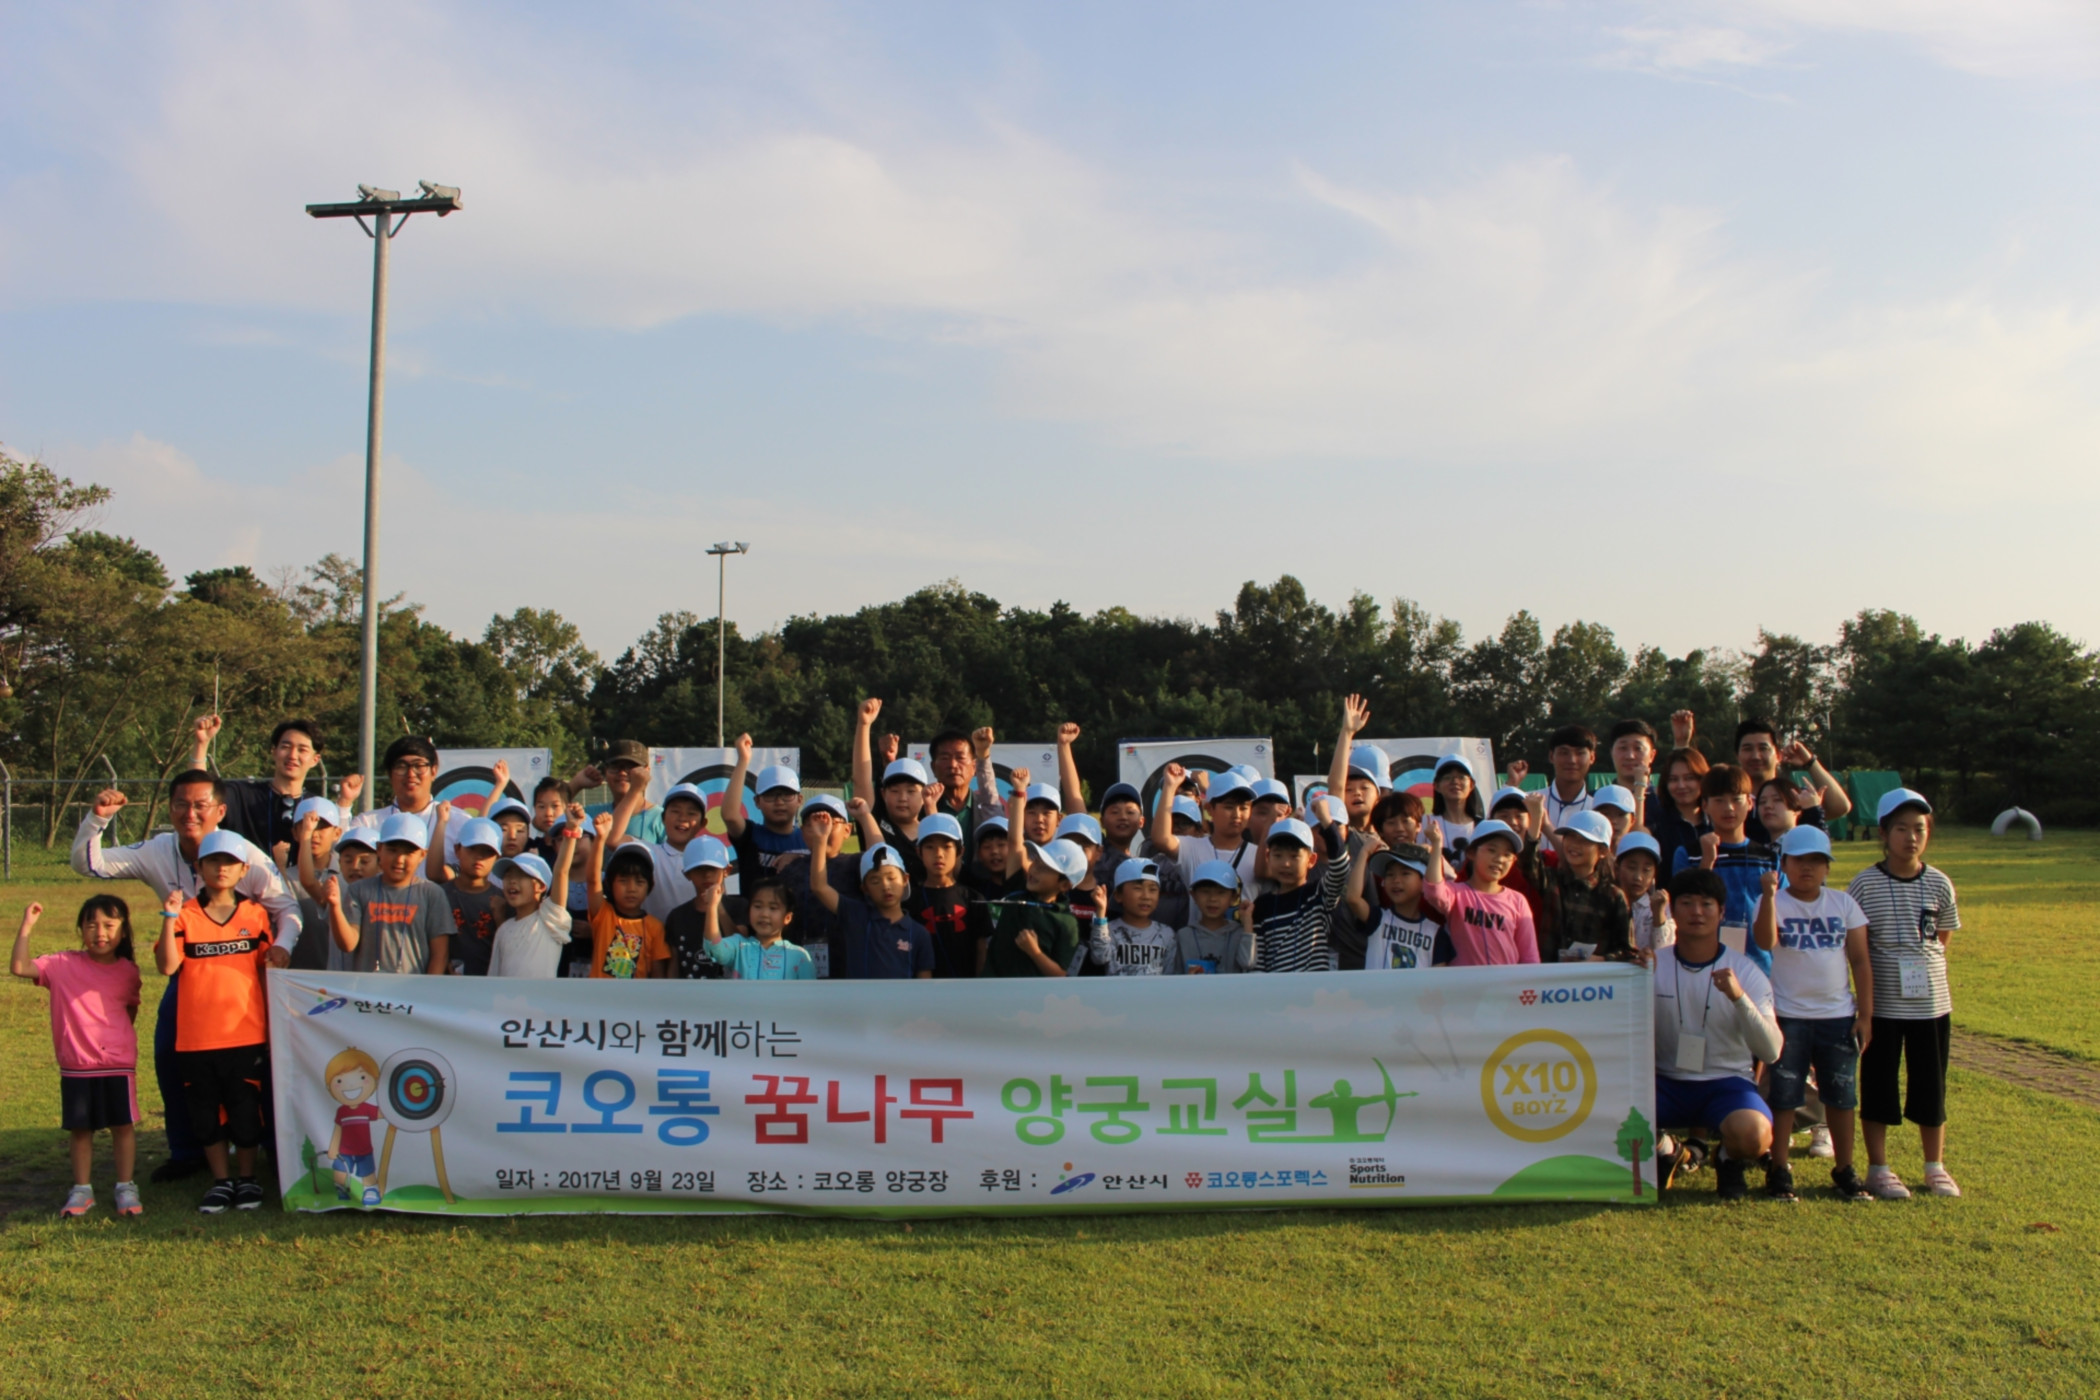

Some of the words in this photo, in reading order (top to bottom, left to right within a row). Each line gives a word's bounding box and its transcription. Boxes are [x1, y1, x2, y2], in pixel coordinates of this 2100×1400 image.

[1778, 917, 1846, 934] STAR
[1383, 923, 1432, 951] INDIGO
[195, 940, 250, 956] Kappa
[1541, 985, 1614, 1004] KOLON
[355, 1000, 413, 1015] 안산시
[500, 1018, 646, 1054] 안산시와
[656, 1019, 802, 1058] 함께하는
[1500, 1060, 1578, 1095] X10
[496, 1068, 720, 1146] 코오롱
[745, 1074, 974, 1144] 꿈나무
[1001, 1069, 1299, 1146] 양궁교실
[1349, 1164, 1386, 1174] Sports
[1349, 1173, 1405, 1184] Nutrition
[496, 1169, 534, 1189] 일자
[558, 1170, 621, 1191] 2017년
[630, 1170, 662, 1192] 9월
[672, 1171, 715, 1192] 23일
[747, 1171, 788, 1192] 장소
[813, 1171, 876, 1192] 코오롱
[886, 1170, 949, 1193] 양궁장
[980, 1169, 1021, 1192] 후원
[1102, 1174, 1168, 1190] 안산시
[1207, 1170, 1328, 1189] 코오롱스포렉스
